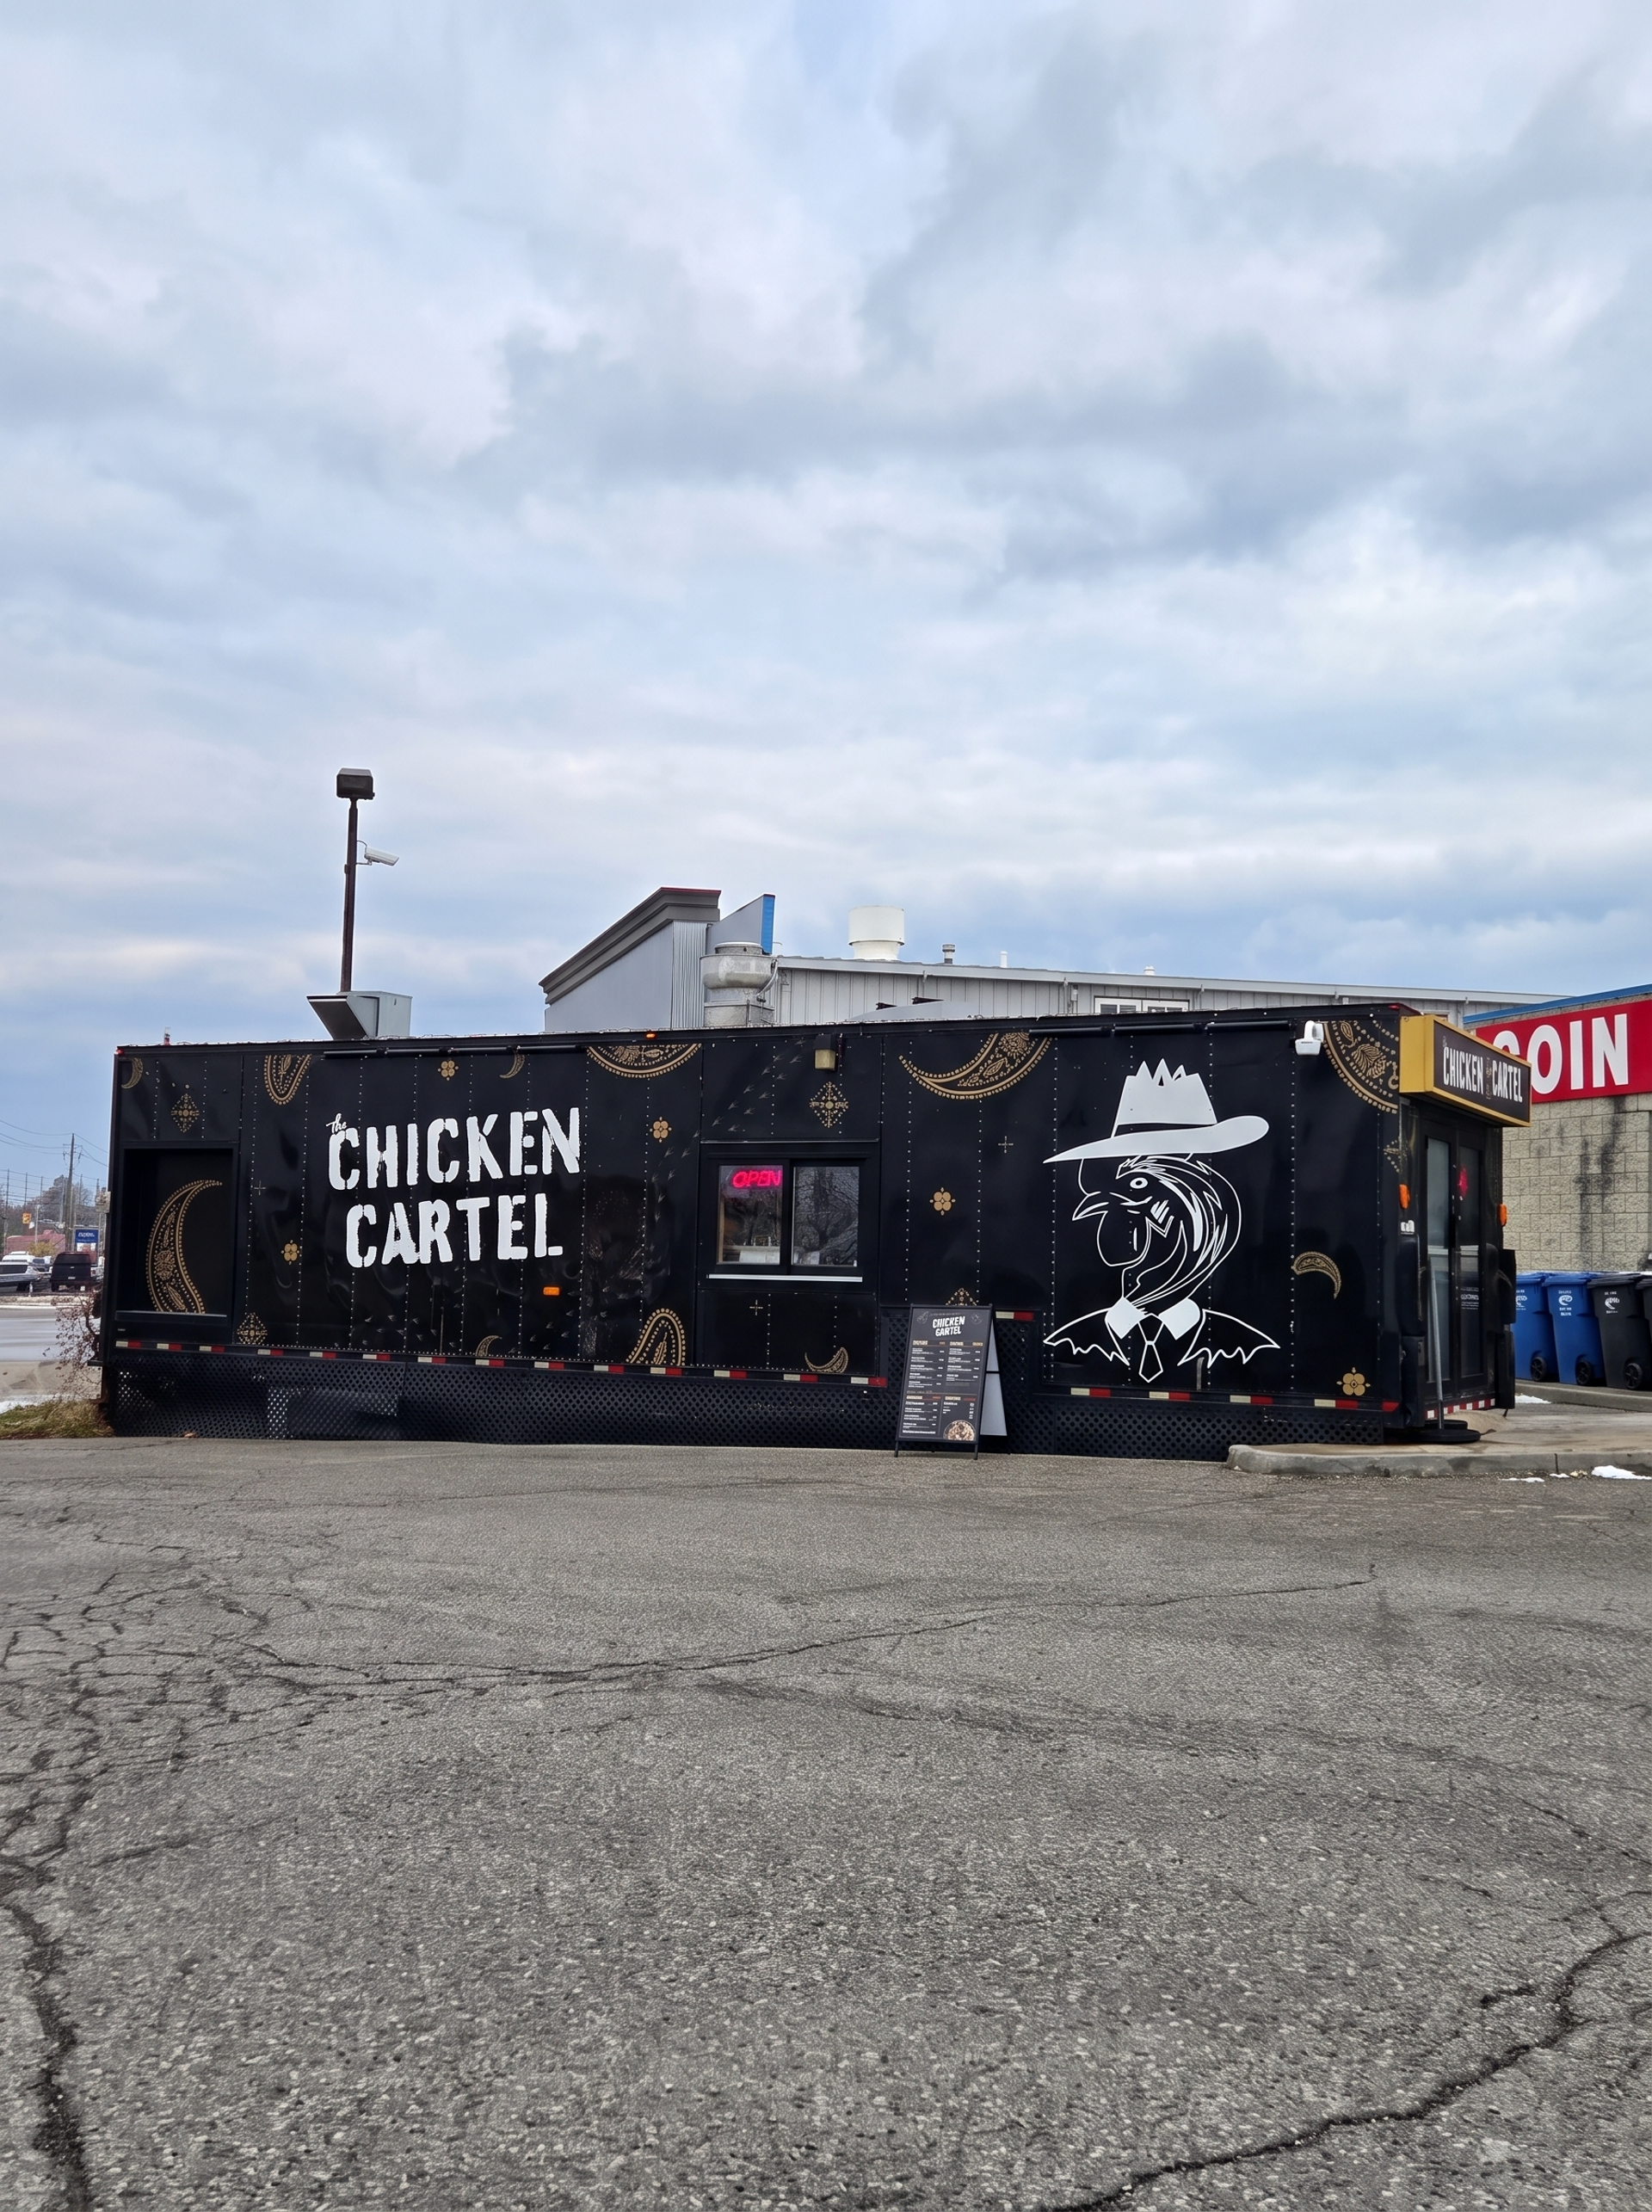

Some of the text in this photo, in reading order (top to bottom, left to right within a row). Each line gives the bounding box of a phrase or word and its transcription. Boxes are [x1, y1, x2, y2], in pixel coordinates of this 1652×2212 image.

[1443, 1046, 1523, 1103] CHICKEN CARTEL
[329, 1107, 581, 1191] CHICKEN
[732, 1170, 782, 1188] OPEN
[346, 1192, 564, 1268] CARTEL
[933, 1316, 965, 1328] CHICKEN
[935, 1326, 961, 1336] CARTEL
